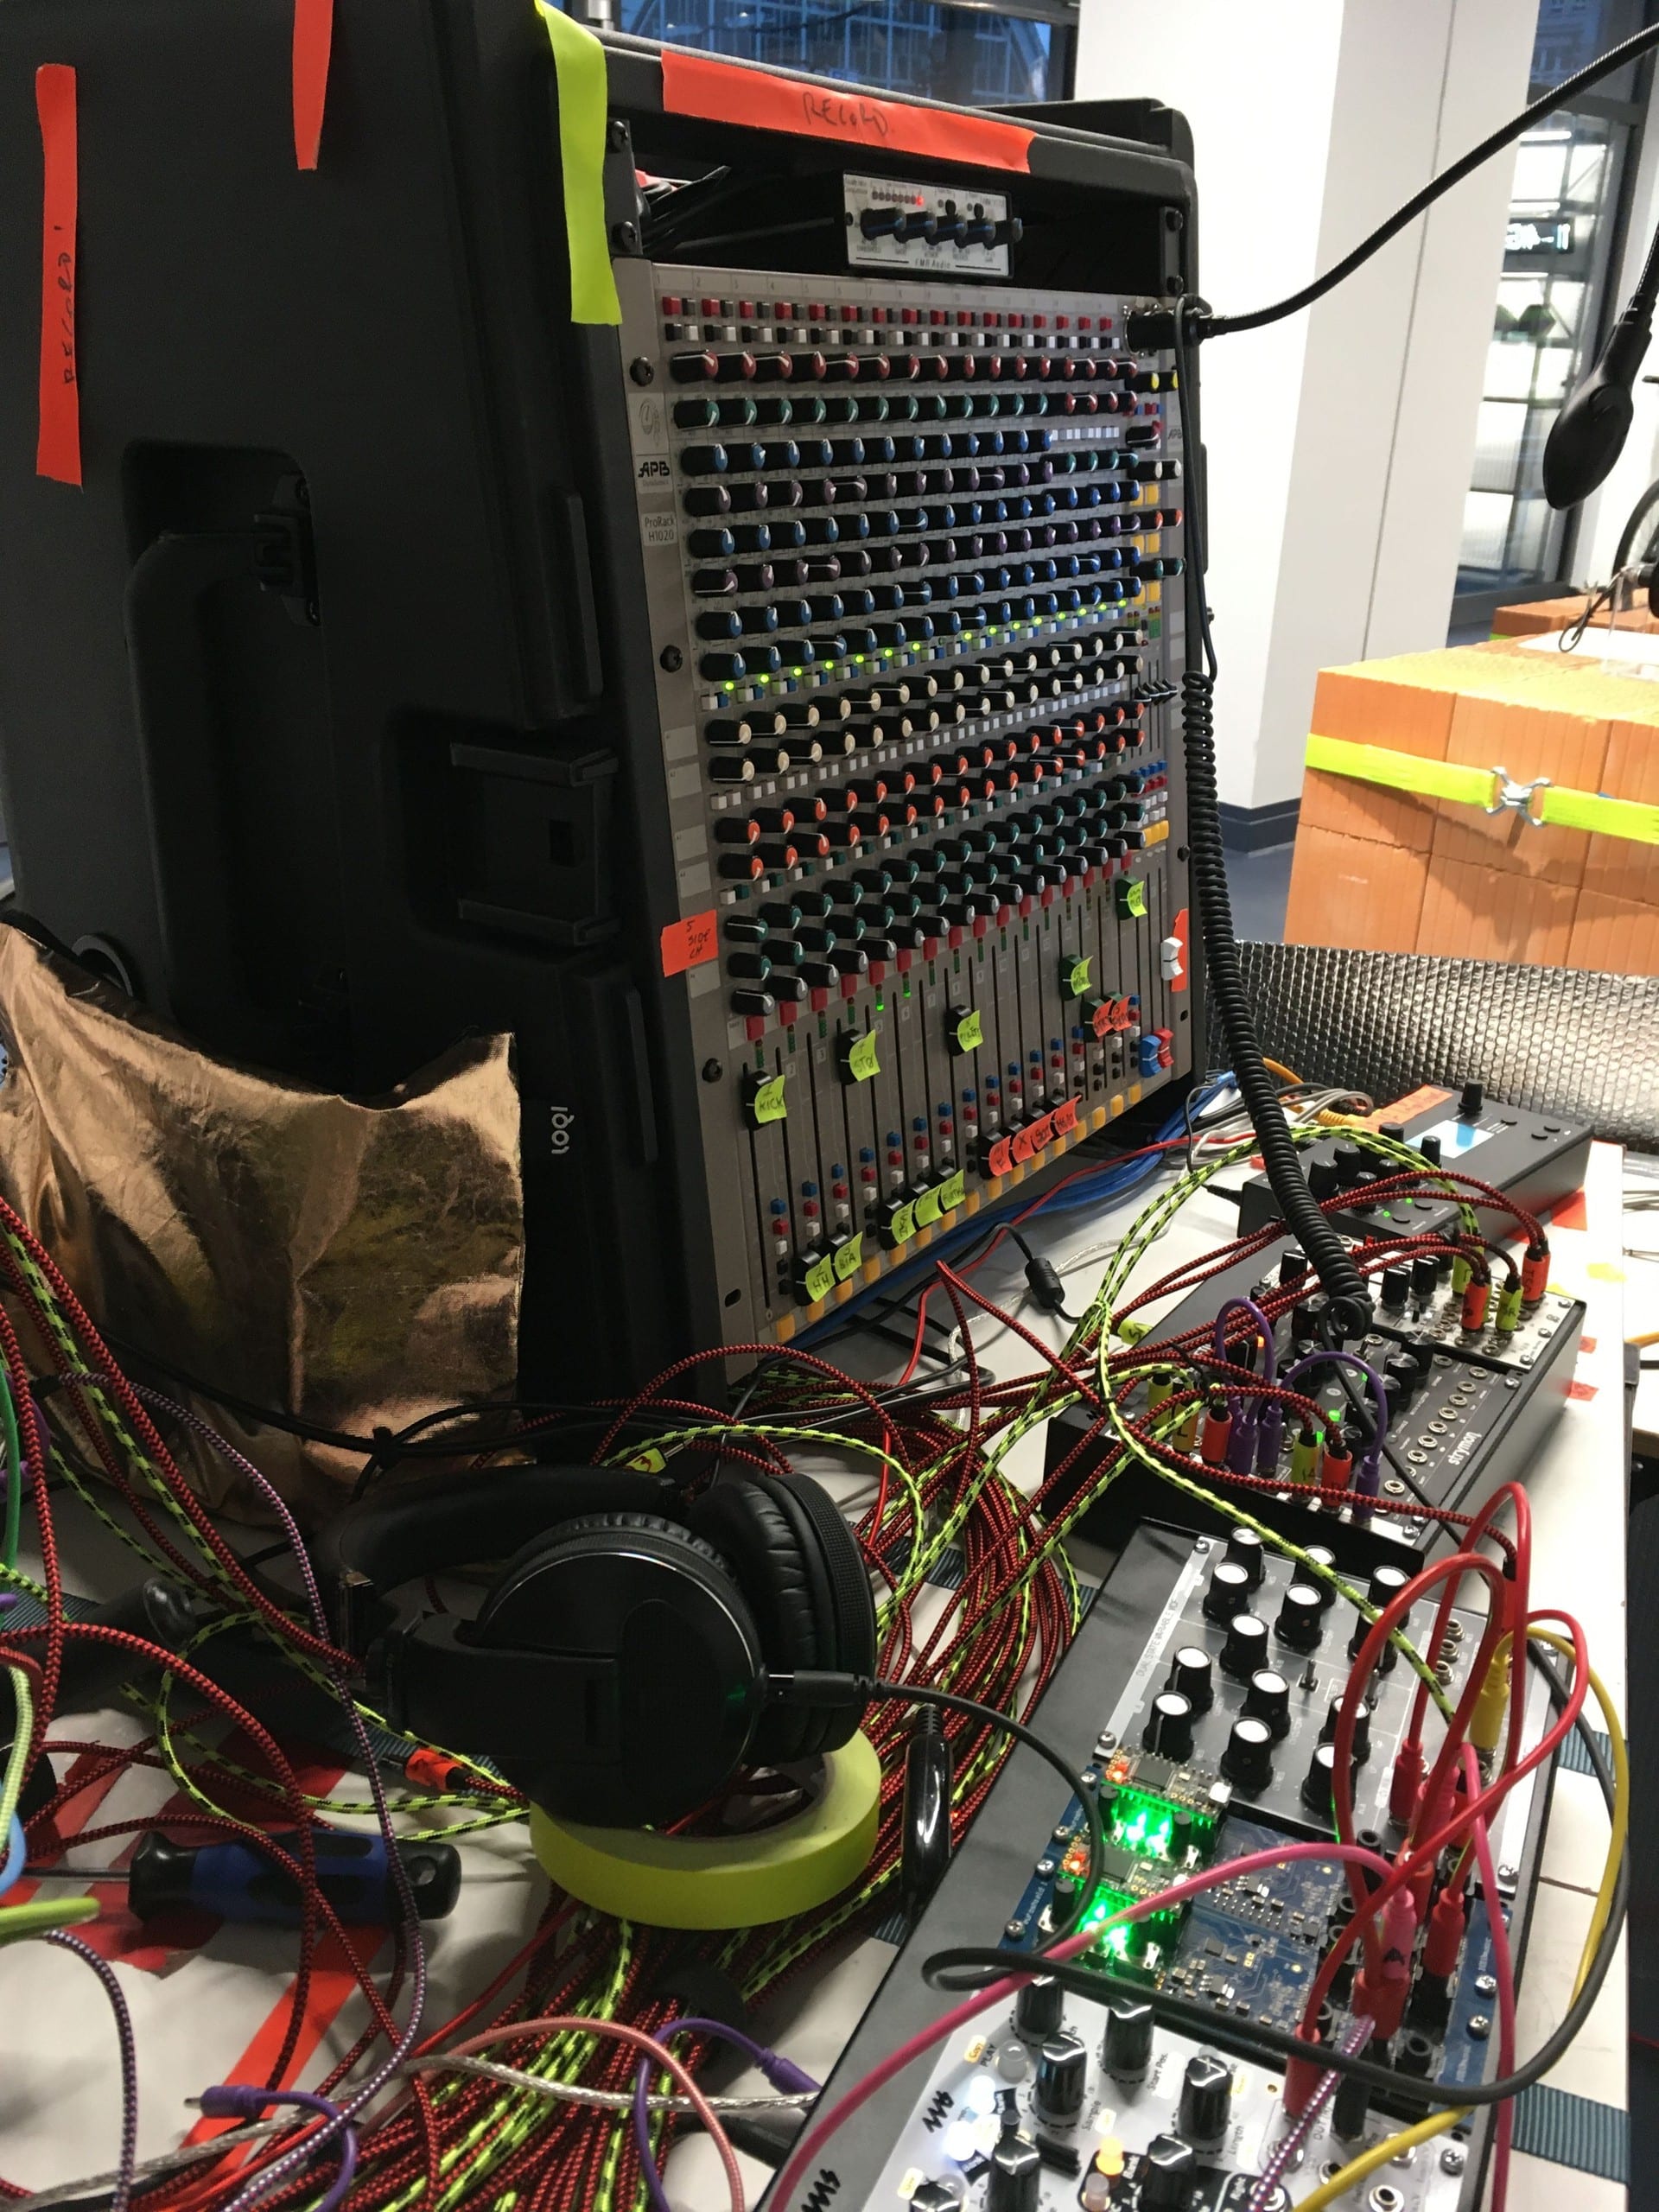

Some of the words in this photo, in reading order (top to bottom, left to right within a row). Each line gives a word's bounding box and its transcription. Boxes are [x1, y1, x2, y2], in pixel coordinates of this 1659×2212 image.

[638, 461, 671, 477] APB
[645, 514, 674, 527] ProRack
[648, 529, 674, 542] H1020
[759, 1095, 785, 1113] KICK
[1447, 1431, 1483, 1466] strymon
[980, 2044, 996, 2068] PLAY
[1081, 2100, 1103, 2131] Sample
[1229, 2125, 1244, 2155] Length
